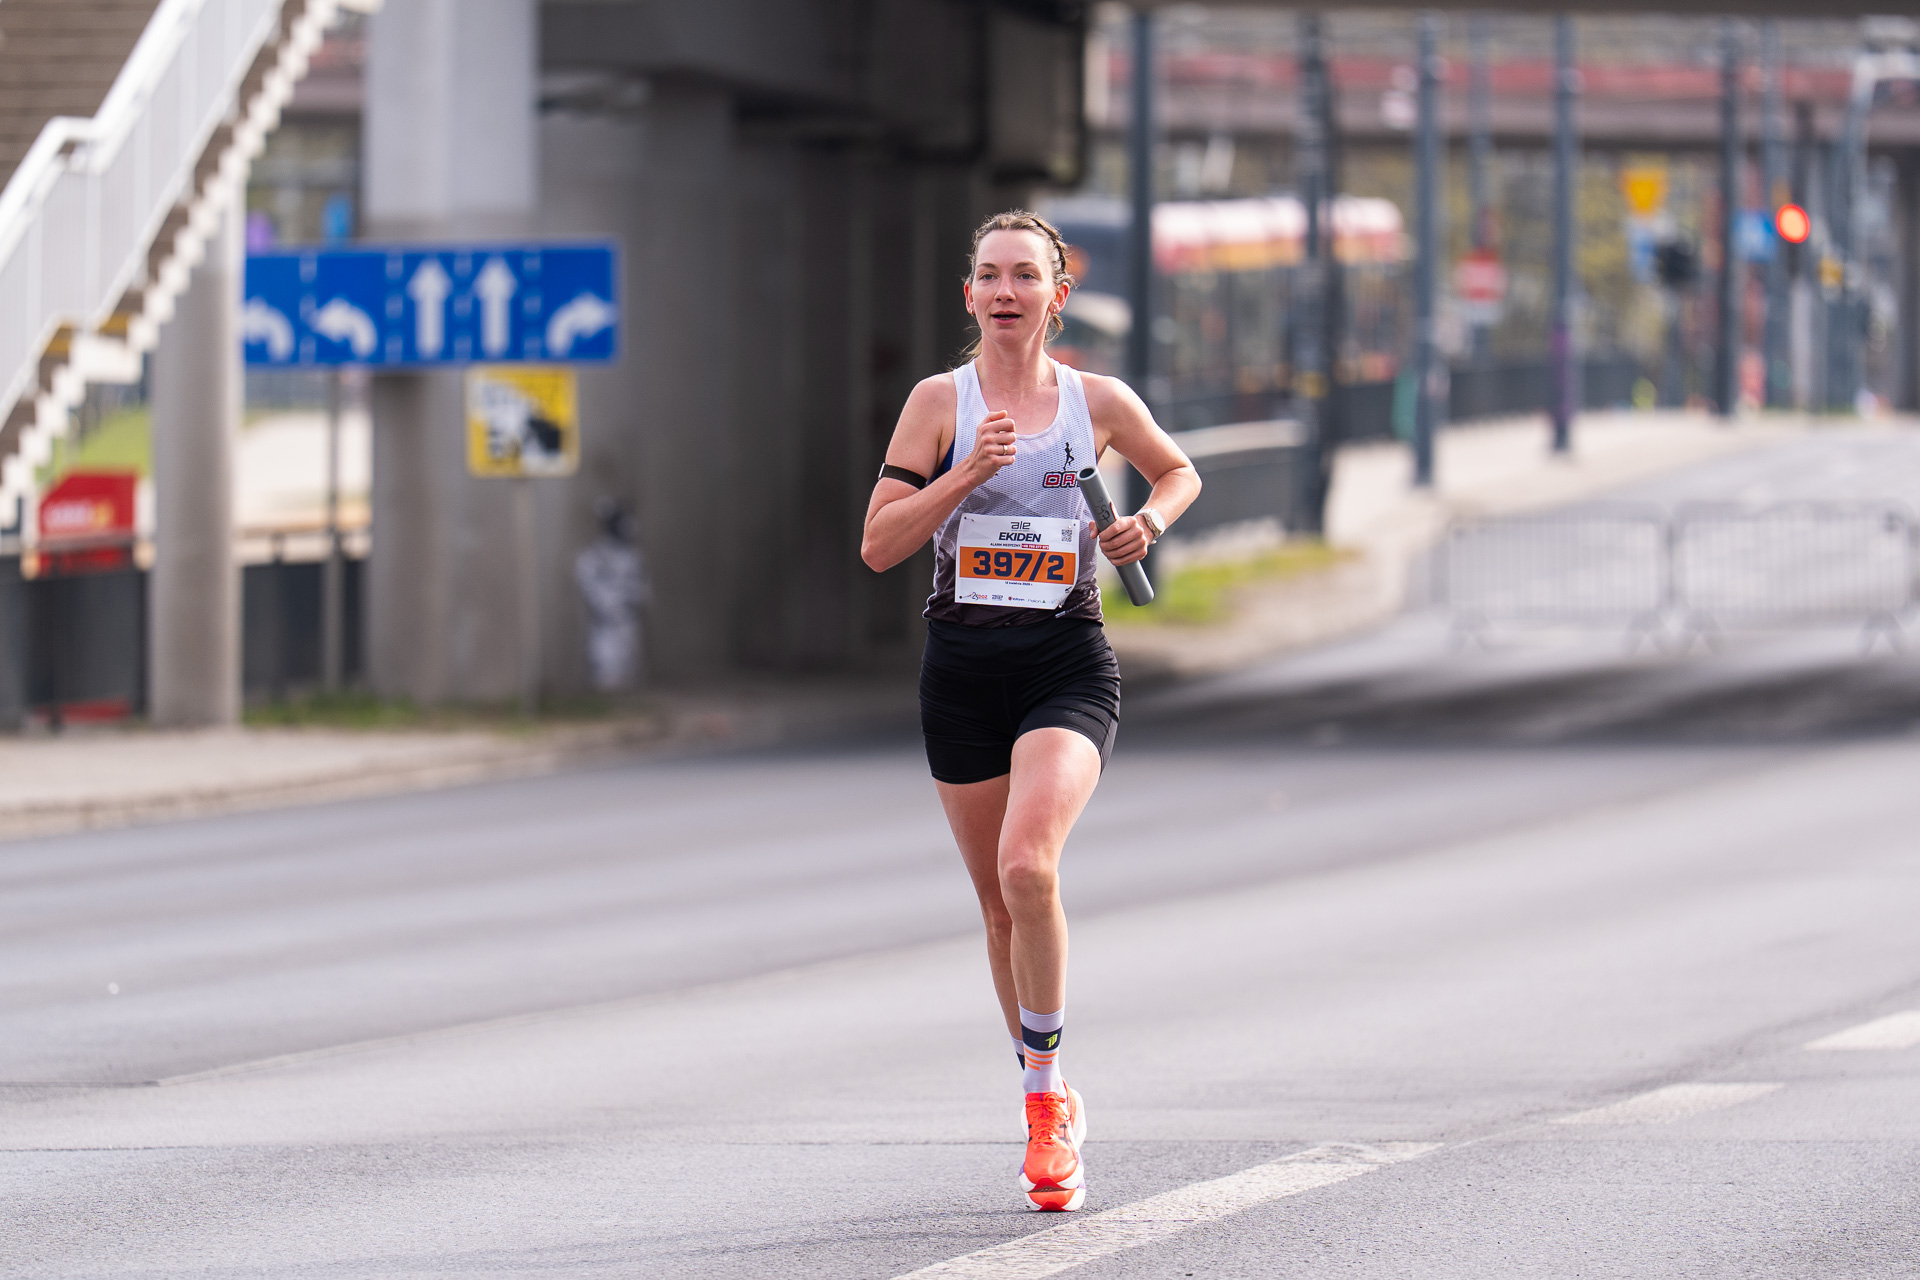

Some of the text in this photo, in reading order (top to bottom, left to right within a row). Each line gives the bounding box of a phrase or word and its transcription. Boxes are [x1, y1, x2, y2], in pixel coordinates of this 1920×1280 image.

[1043, 471, 1078, 488] OR
[998, 532, 1042, 543] EKIDEN
[972, 550, 1065, 581] 397/2
